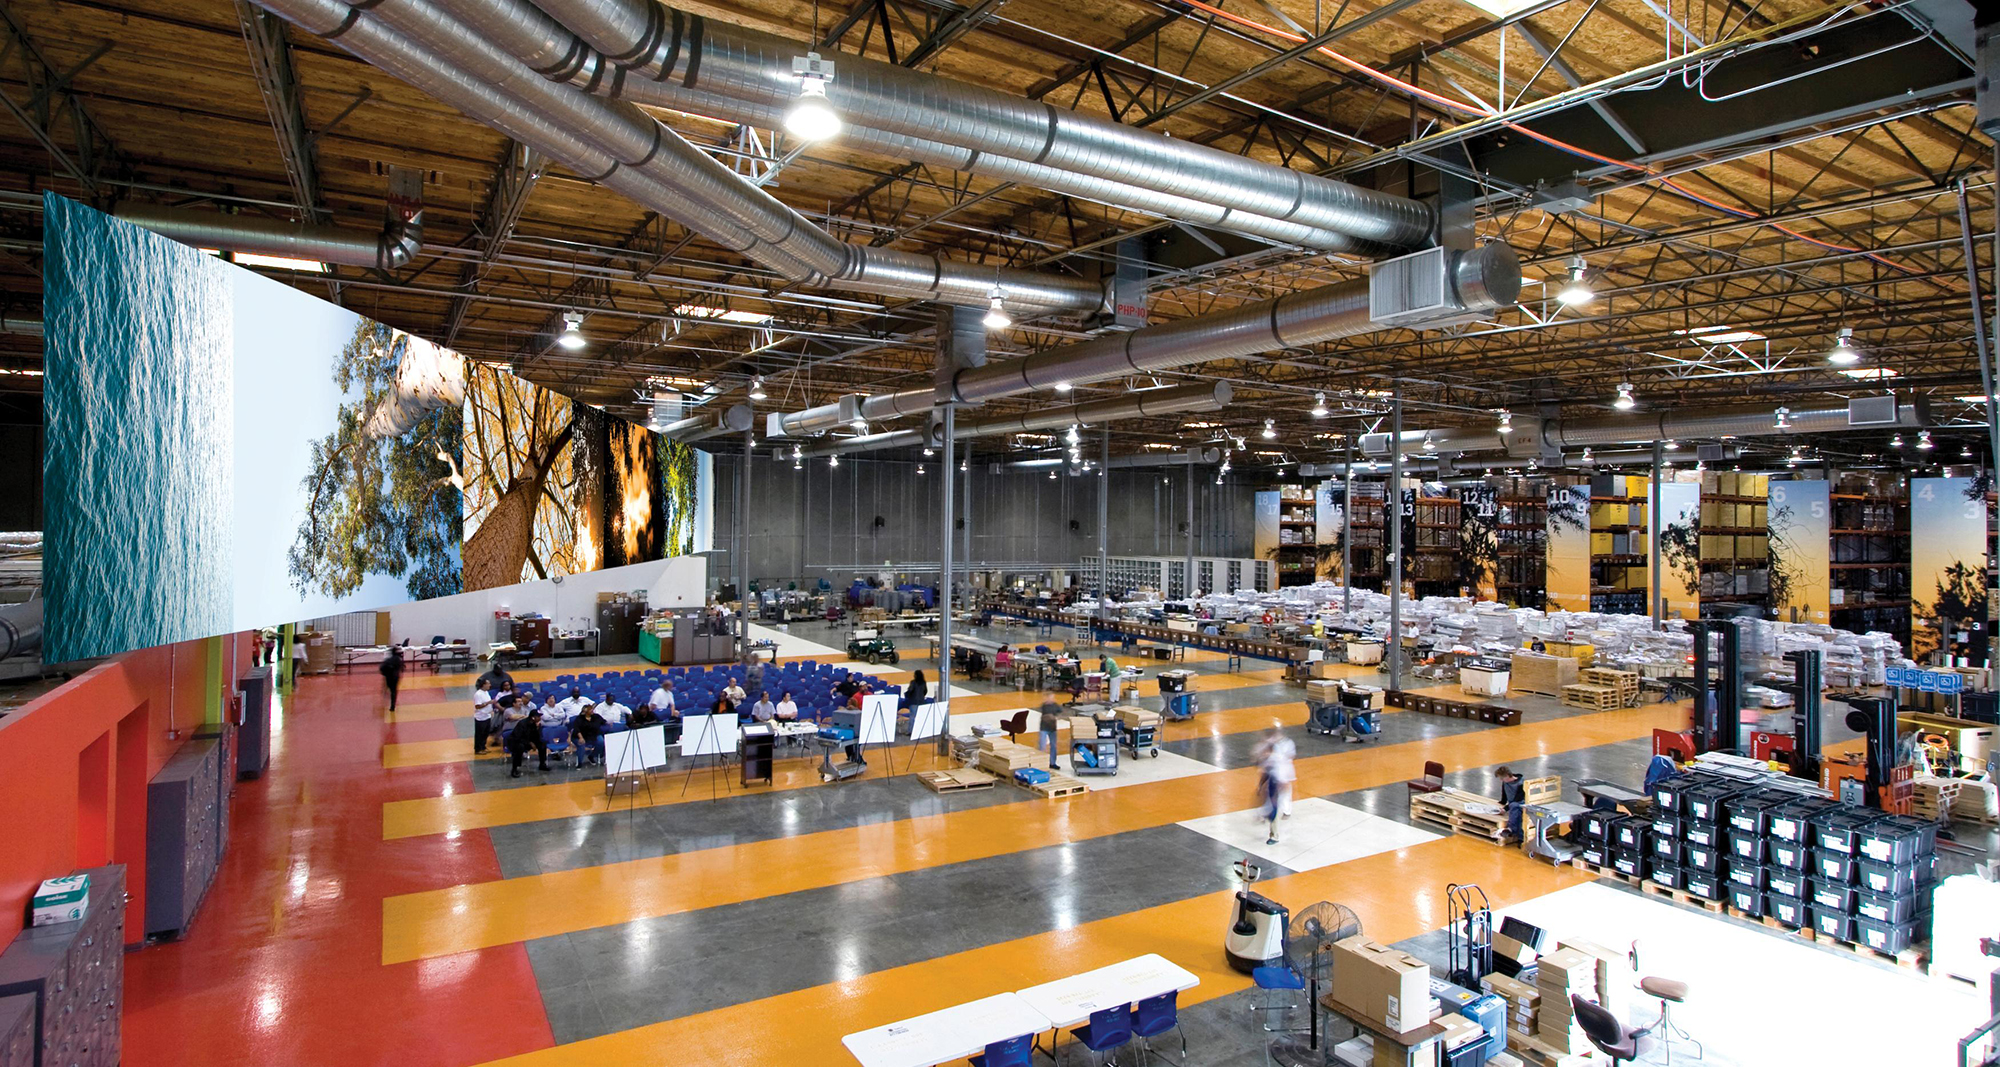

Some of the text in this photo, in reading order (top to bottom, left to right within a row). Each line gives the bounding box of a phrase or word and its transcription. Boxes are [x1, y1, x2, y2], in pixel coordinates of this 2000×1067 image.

[1117, 304, 1146, 318] PHP-10
[1318, 493, 1332, 505] 16
[1463, 491, 1478, 504] 12
[1550, 489, 1570, 504] 10
[1772, 486, 1786, 503] 6
[1918, 484, 1935, 502] 4
[1257, 494, 1269, 506] 18
[1267, 504, 1278, 515] 17
[1330, 504, 1343, 515] 15
[1400, 504, 1413, 515] 13
[1477, 503, 1494, 517] 11
[1577, 502, 1587, 516] 9
[1683, 502, 1695, 517] 7
[1811, 501, 1826, 518] 5
[1964, 500, 1980, 519] 3
[1772, 607, 1779, 615] 6
[1817, 611, 1824, 619] 5
[1972, 622, 1981, 631] 3
